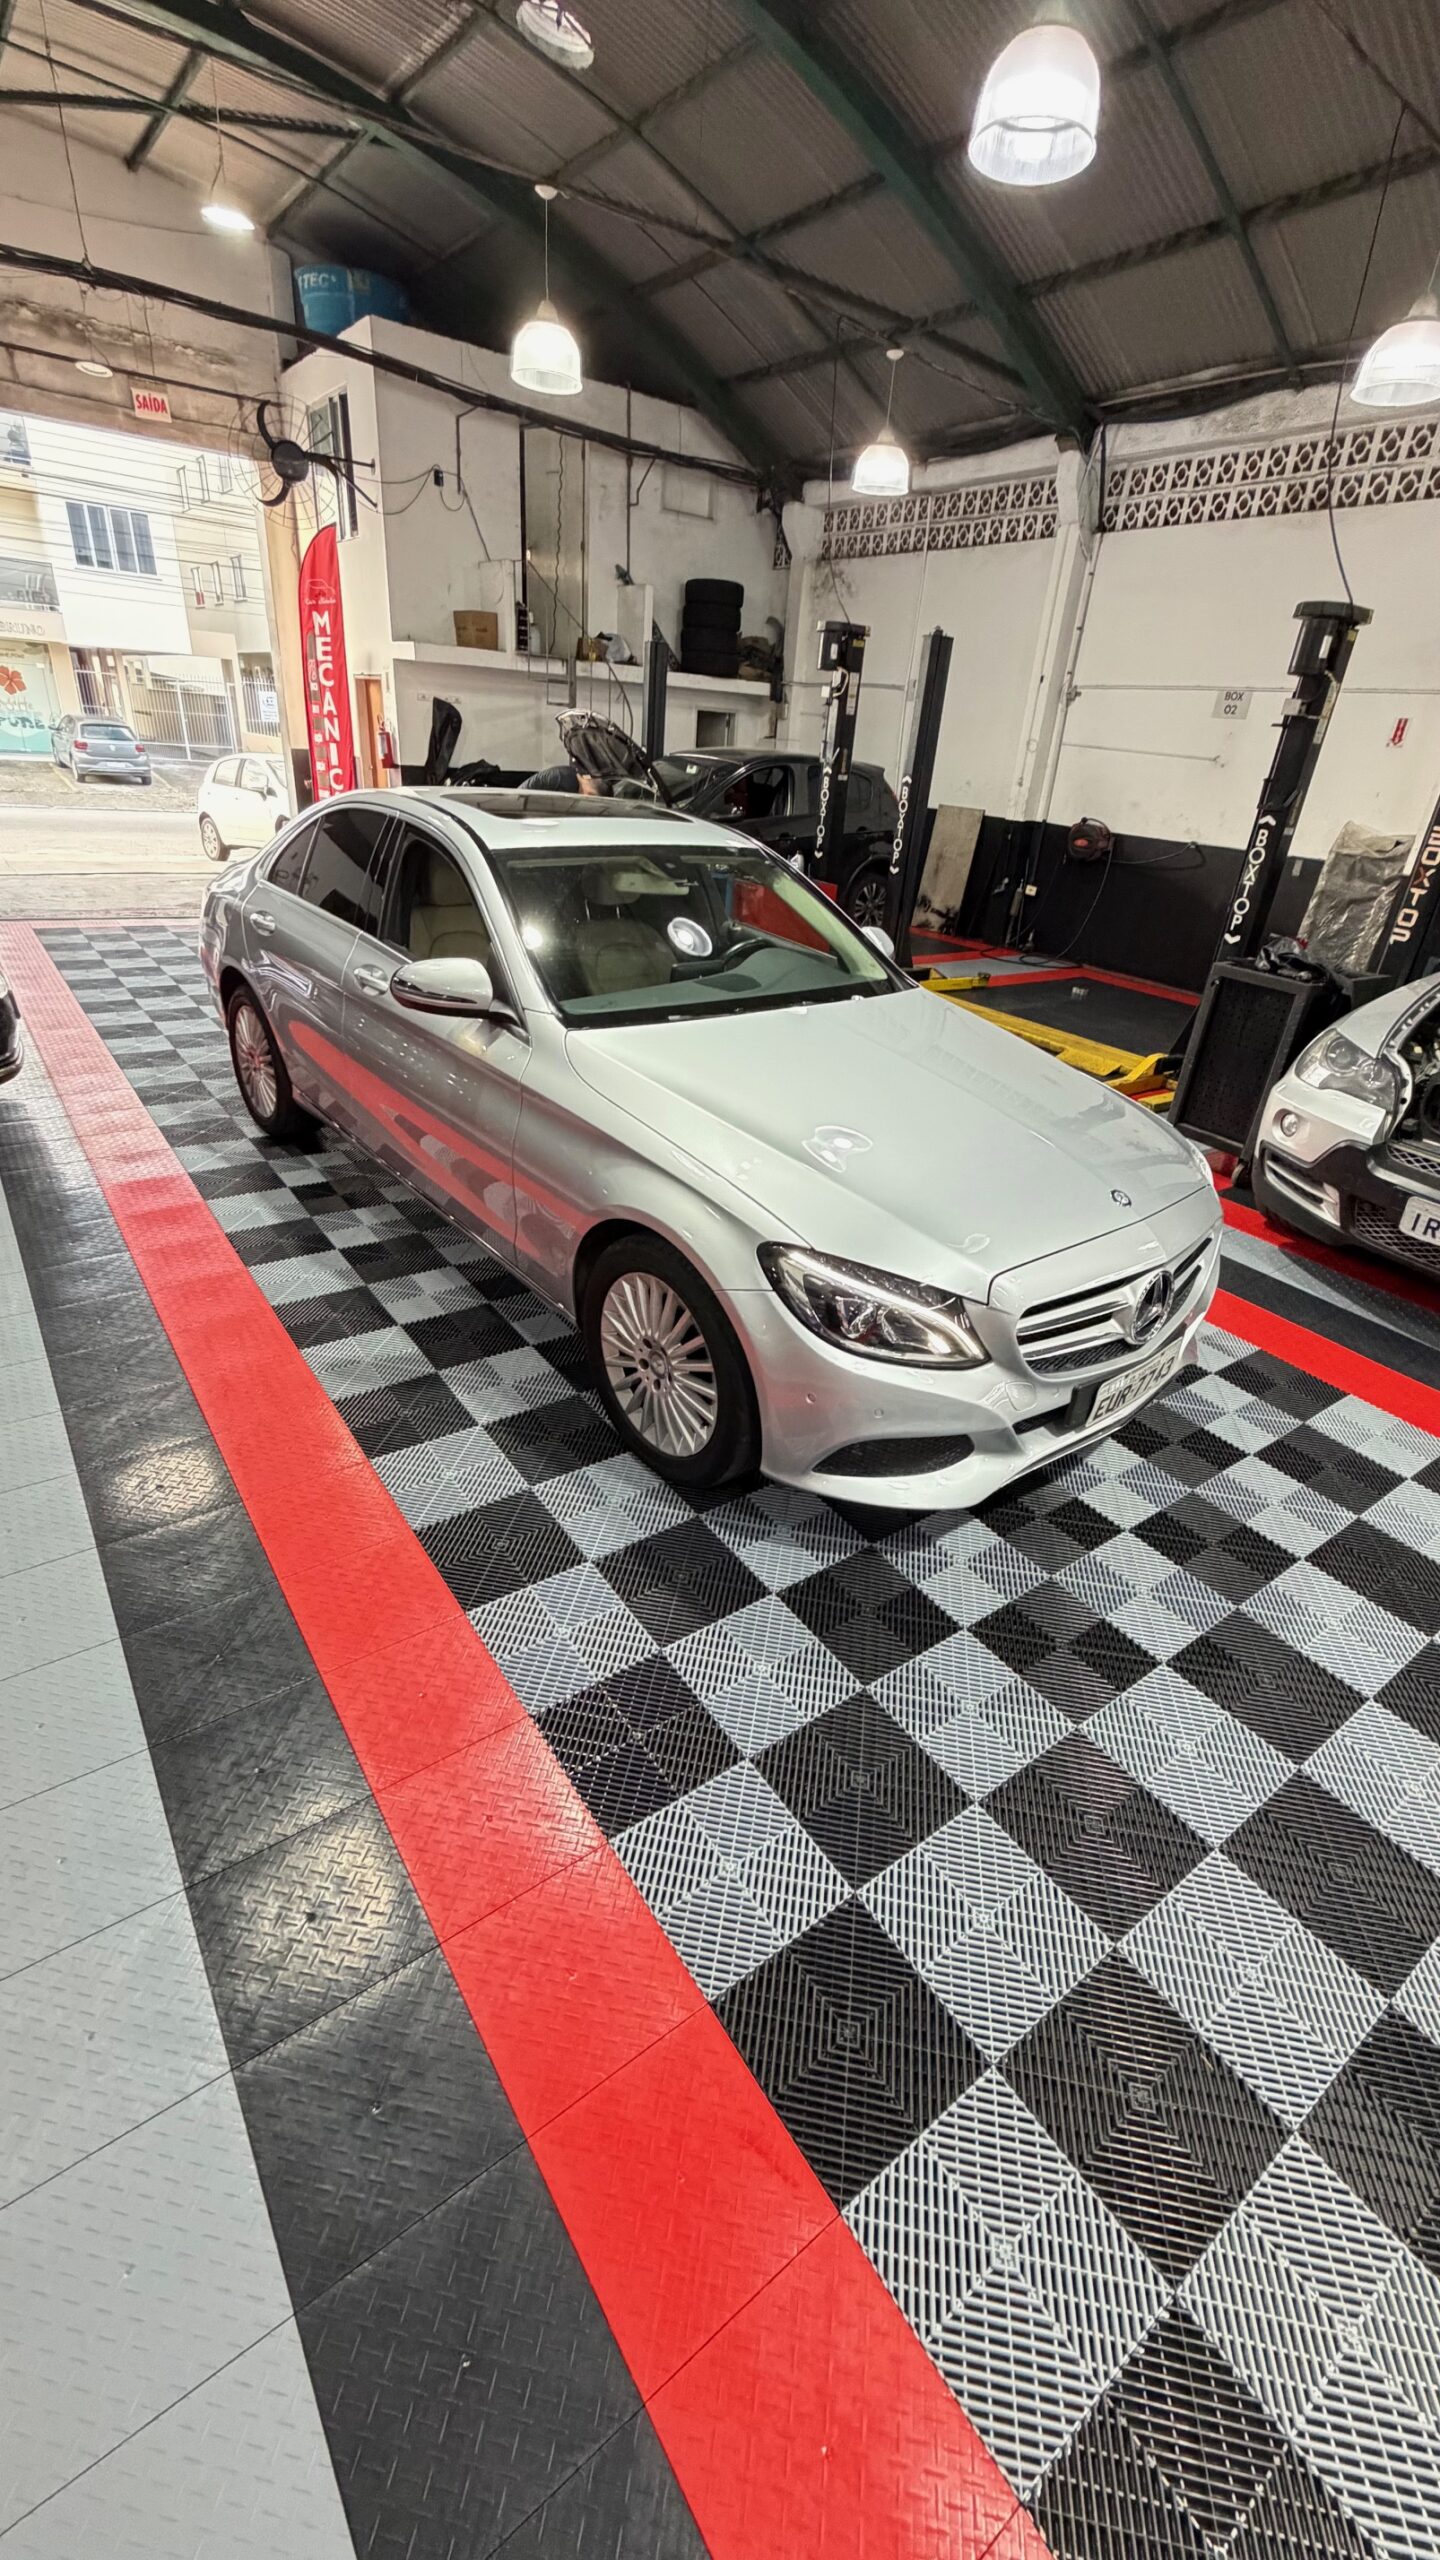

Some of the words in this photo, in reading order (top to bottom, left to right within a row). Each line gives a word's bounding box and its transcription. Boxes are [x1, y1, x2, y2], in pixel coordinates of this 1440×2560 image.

[135, 392, 168, 415] SAÍDA
[311, 609, 345, 797] MECANIC
[1223, 704, 1237, 715] 02
[1224, 691, 1244, 701] BOX
[816, 776, 830, 849] BOXTOP
[892, 786, 908, 865] BOXTOP
[1230, 828, 1269, 931] BOXTOP
